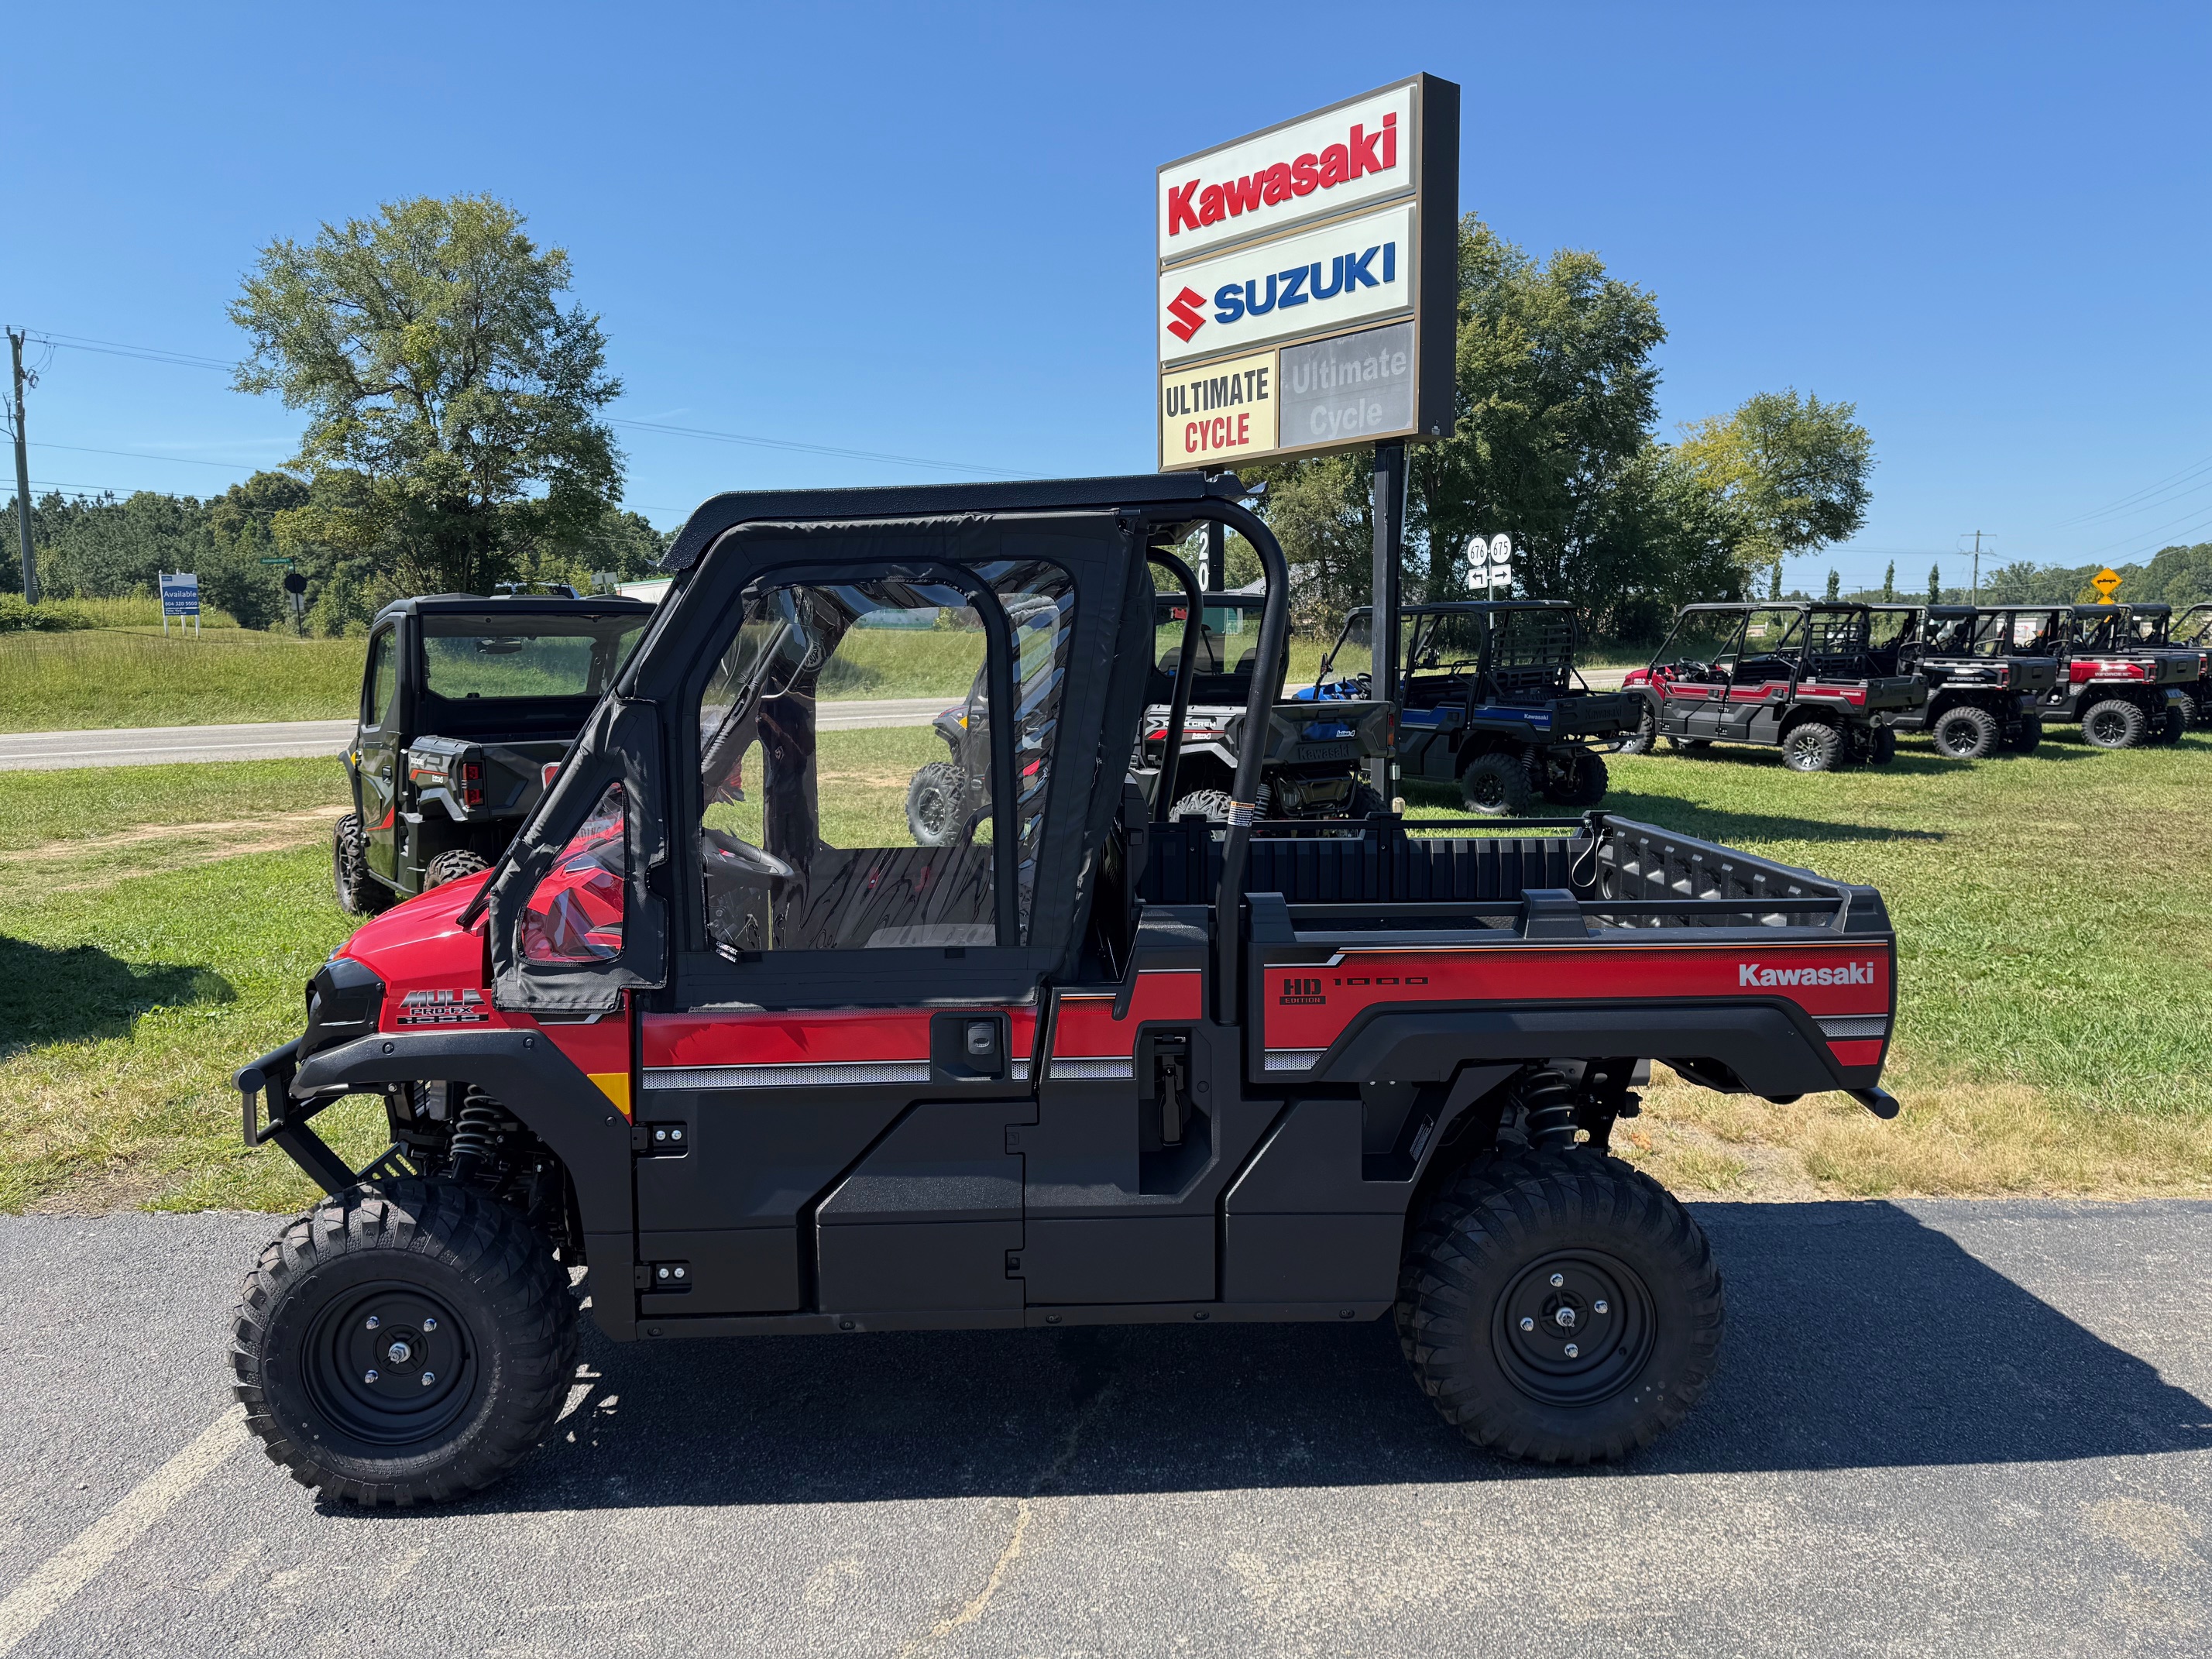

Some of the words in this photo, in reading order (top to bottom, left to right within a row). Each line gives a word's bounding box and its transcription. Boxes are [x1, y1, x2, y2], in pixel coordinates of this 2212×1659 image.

[1169, 112, 1396, 235] Kawasaki
[1214, 241, 1395, 324] SUZUKI
[1293, 349, 1407, 394] Ultimate
[1166, 367, 1269, 417] ULTIMATE
[1310, 398, 1382, 439] Cycle
[1185, 413, 1249, 453] CYCLE
[1470, 544, 1484, 559] 676
[1493, 541, 1508, 555] 675
[1297, 744, 1349, 760] Kawasaki
[1739, 961, 1874, 987] Kawasaki
[398, 988, 486, 1008] MULE
[1283, 978, 1321, 995] HD
[406, 1015, 479, 1023] 1000
[410, 1007, 474, 1015] PRO-FX
